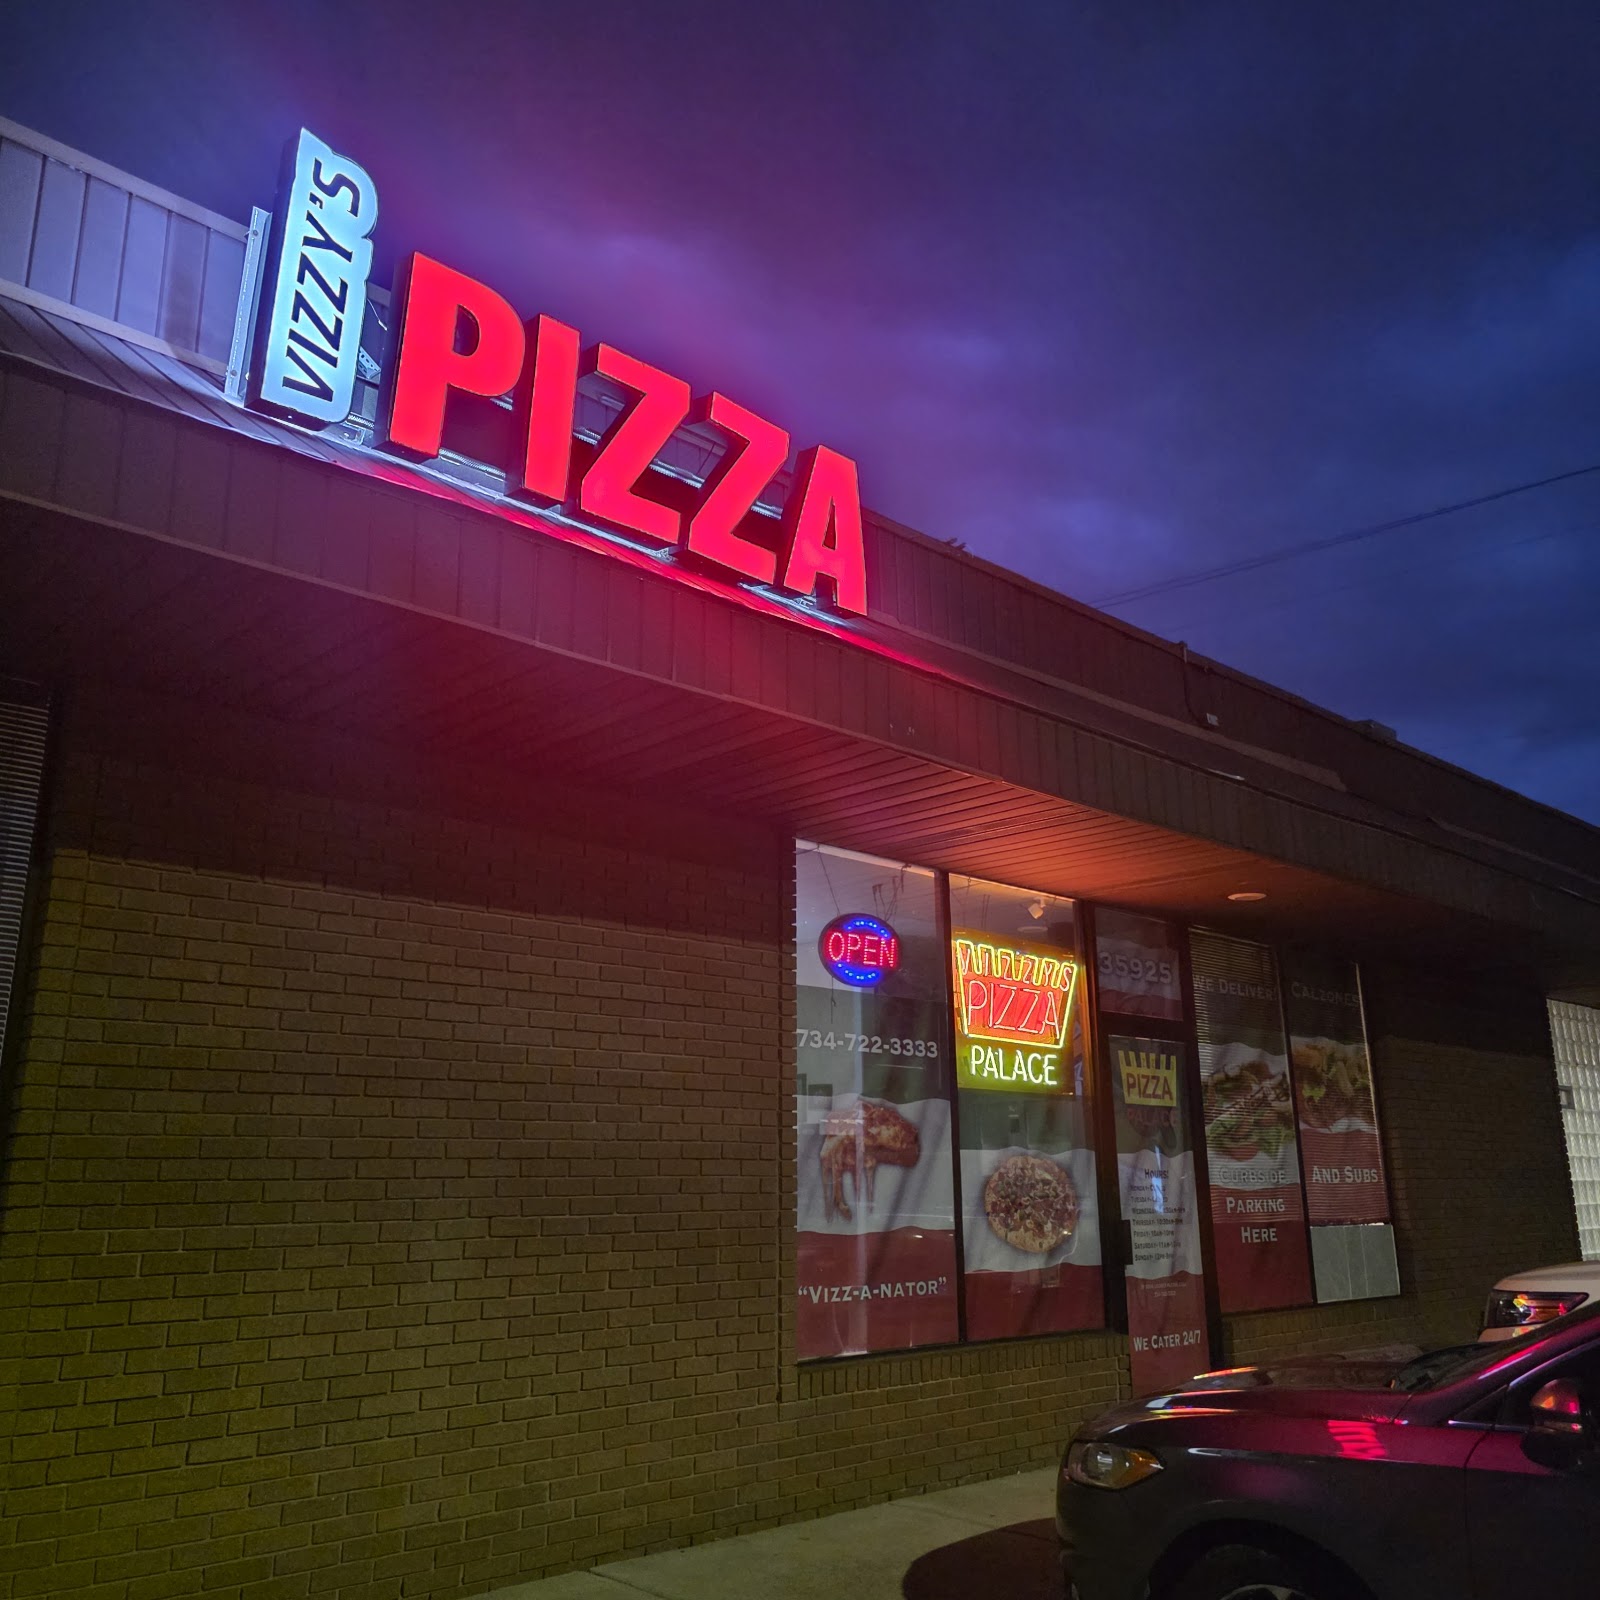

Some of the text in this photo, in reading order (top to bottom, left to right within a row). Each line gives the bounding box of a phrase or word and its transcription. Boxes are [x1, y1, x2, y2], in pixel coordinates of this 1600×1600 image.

[282, 156, 362, 403] VIZZY'S
[388, 251, 868, 616] PIZZA
[827, 931, 896, 968] OPEN
[1099, 951, 1173, 985] 35925
[966, 979, 1060, 1040] PIZZA
[796, 1028, 939, 1059] 734-722-3333
[970, 1044, 1059, 1086] PALACE
[1126, 1072, 1174, 1101] PIZZA
[1219, 1167, 1286, 1184] CURBSIDE
[1311, 1164, 1379, 1184] AND SUBS
[1226, 1196, 1286, 1214] PARKING
[1240, 1226, 1278, 1244] HERE
[1133, 1329, 1201, 1352] WE CATER 24/7
